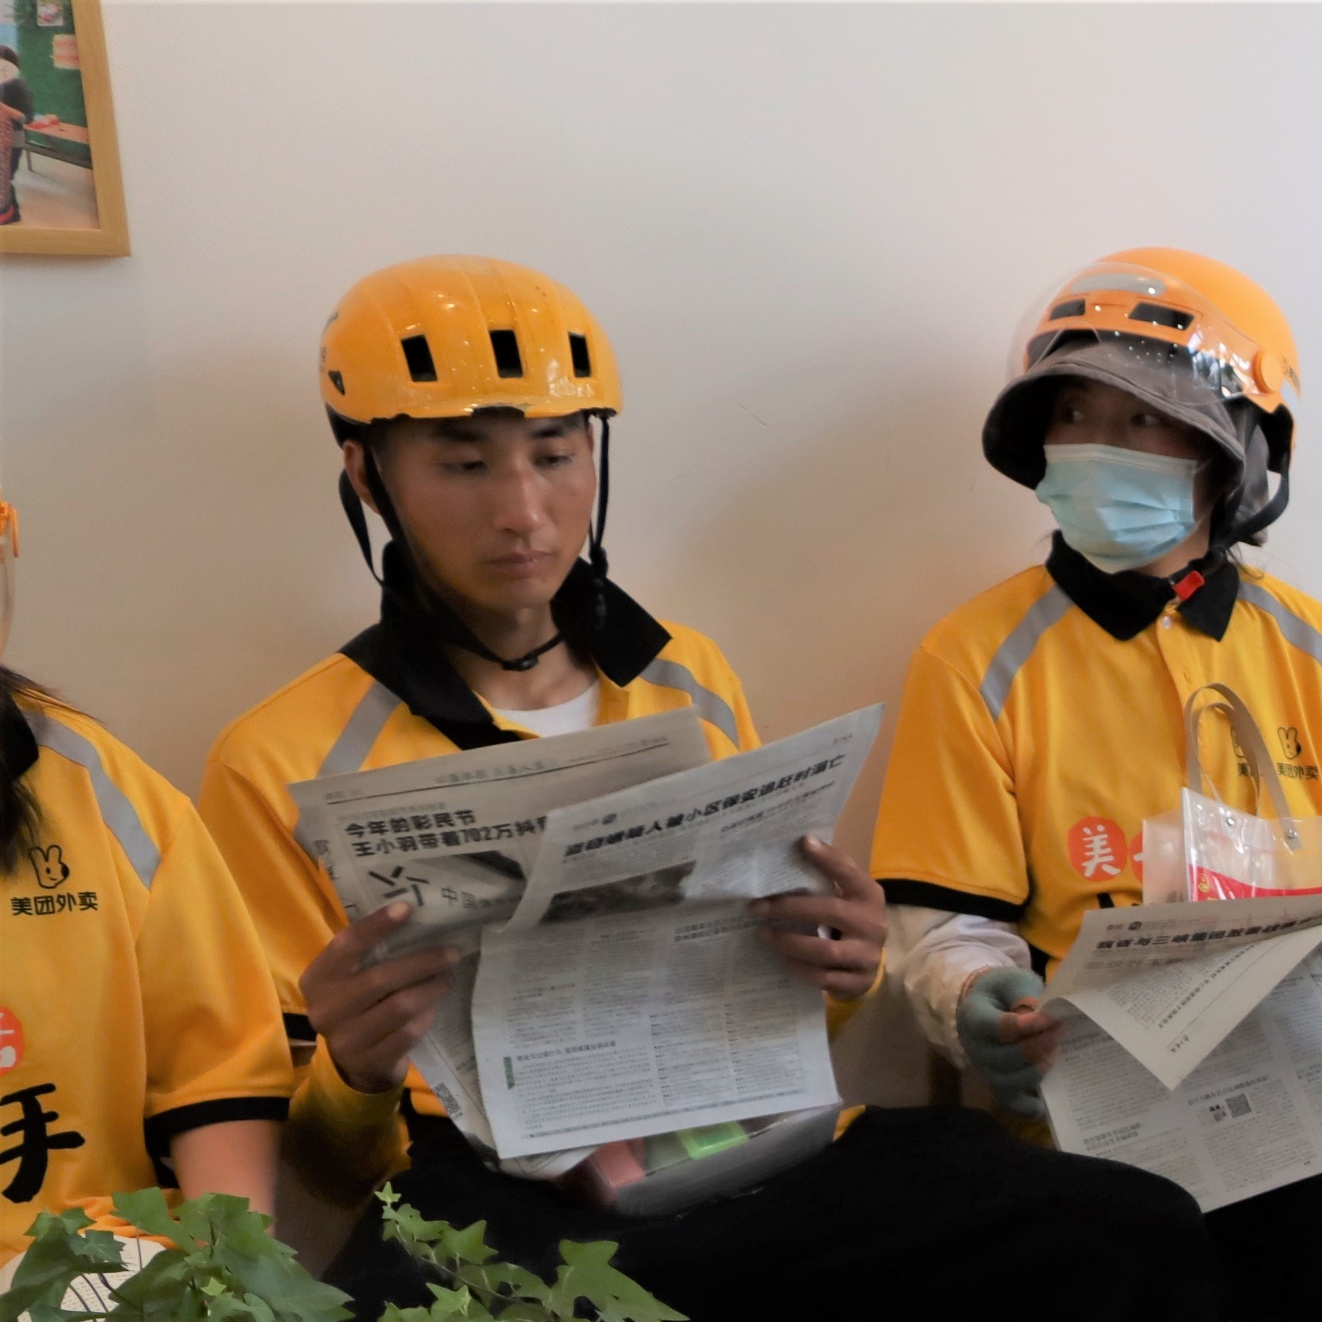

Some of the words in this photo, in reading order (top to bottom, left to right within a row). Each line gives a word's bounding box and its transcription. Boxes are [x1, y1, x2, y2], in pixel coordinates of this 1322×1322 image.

[11, 892, 98, 916] 美团外卖
[0, 1083, 86, 1203] 手
